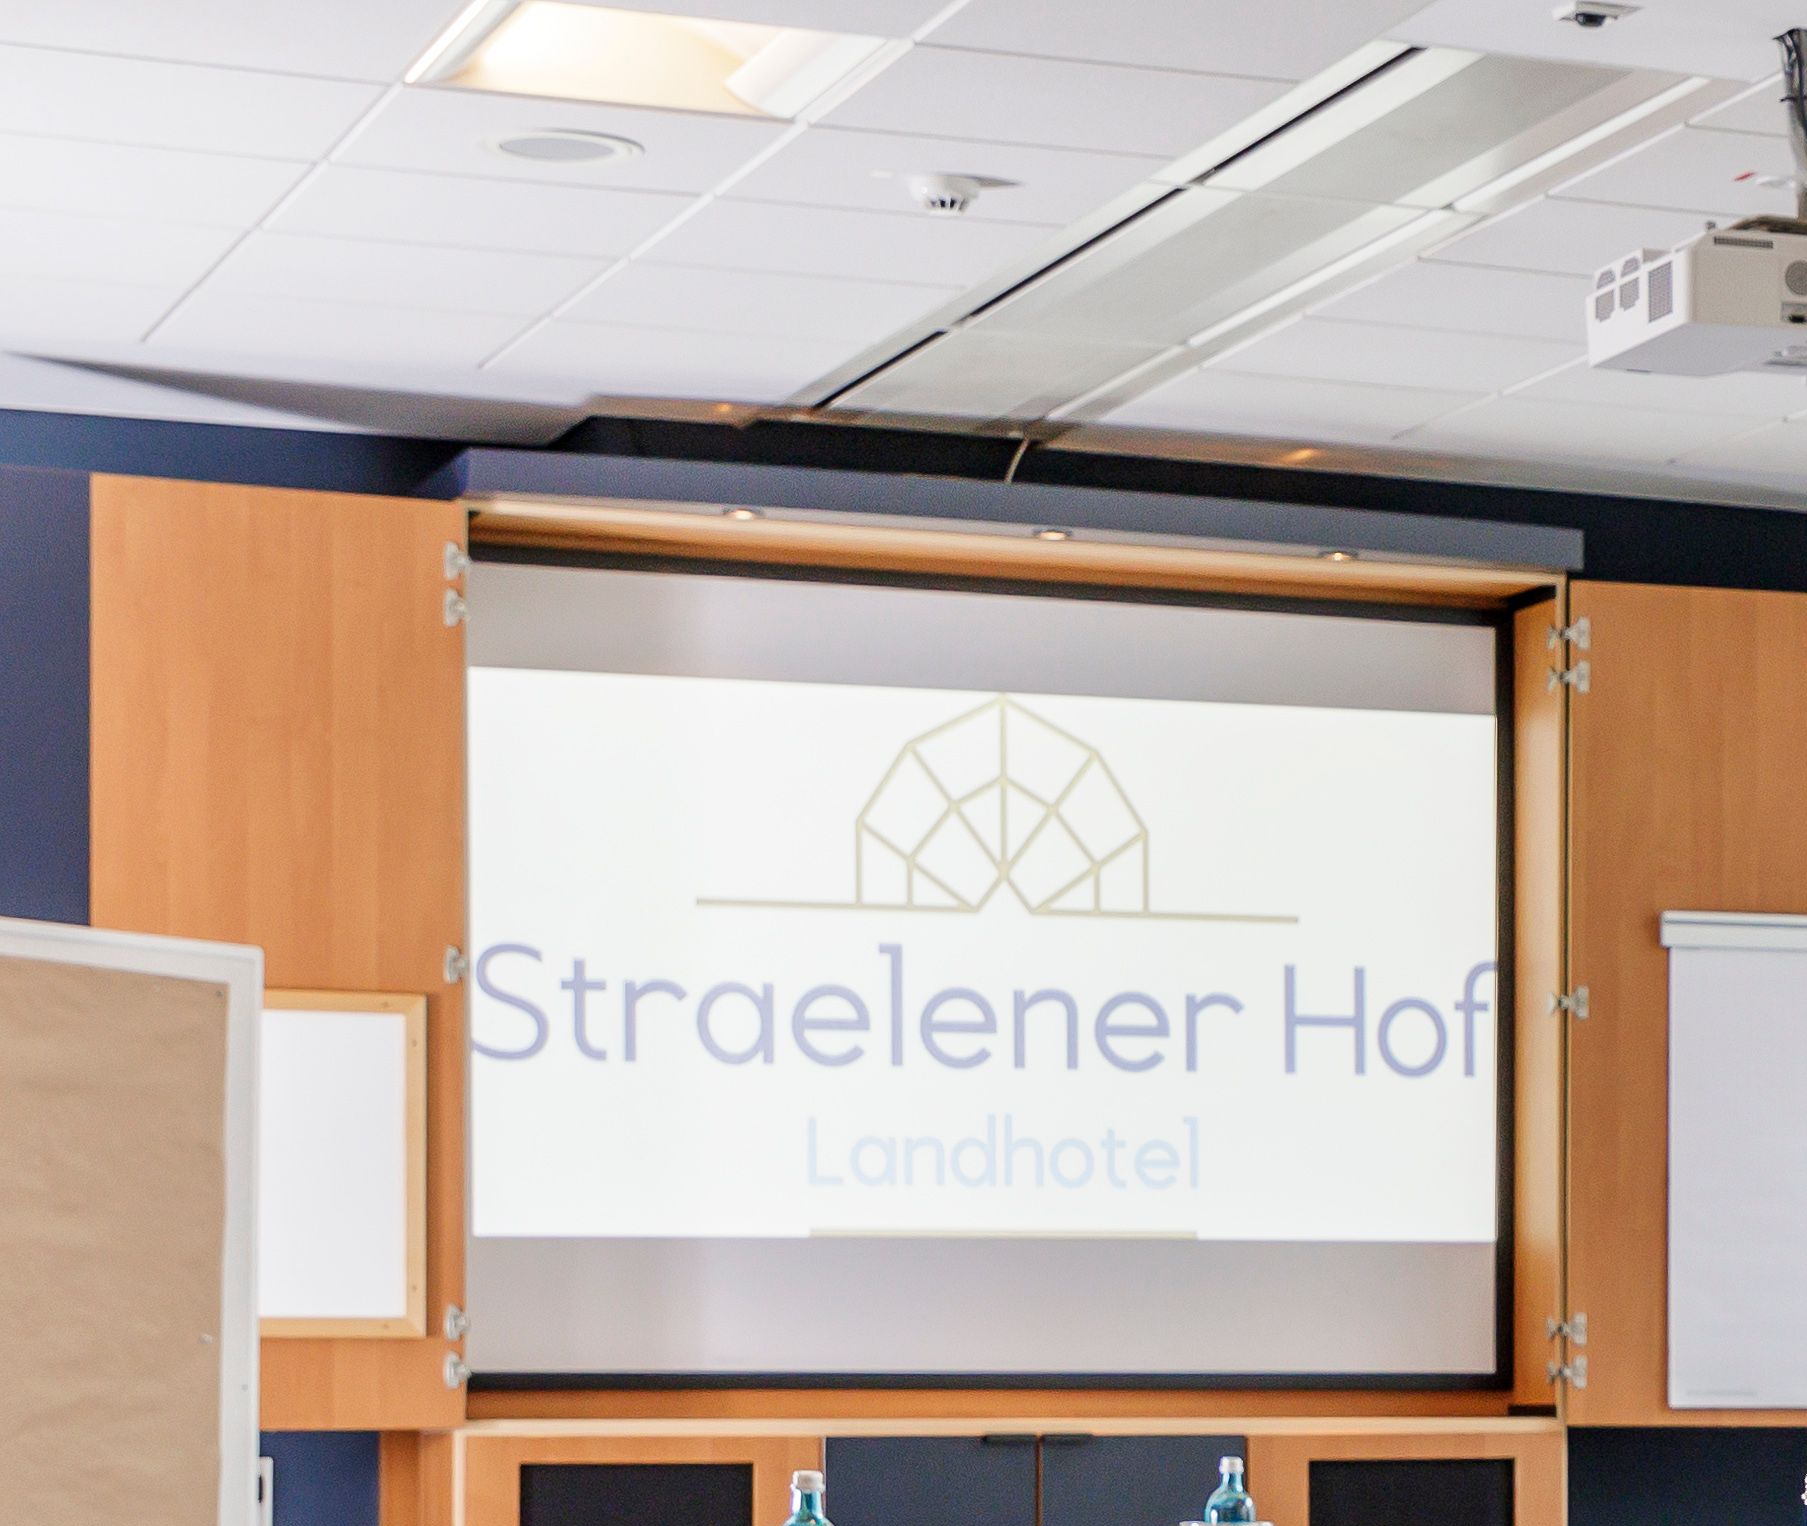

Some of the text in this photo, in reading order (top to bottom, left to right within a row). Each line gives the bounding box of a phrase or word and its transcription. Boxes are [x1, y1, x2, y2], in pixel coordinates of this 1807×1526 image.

[470, 940, 1498, 1081] Straelener Hof
[805, 1114, 1201, 1192] Landhotel
